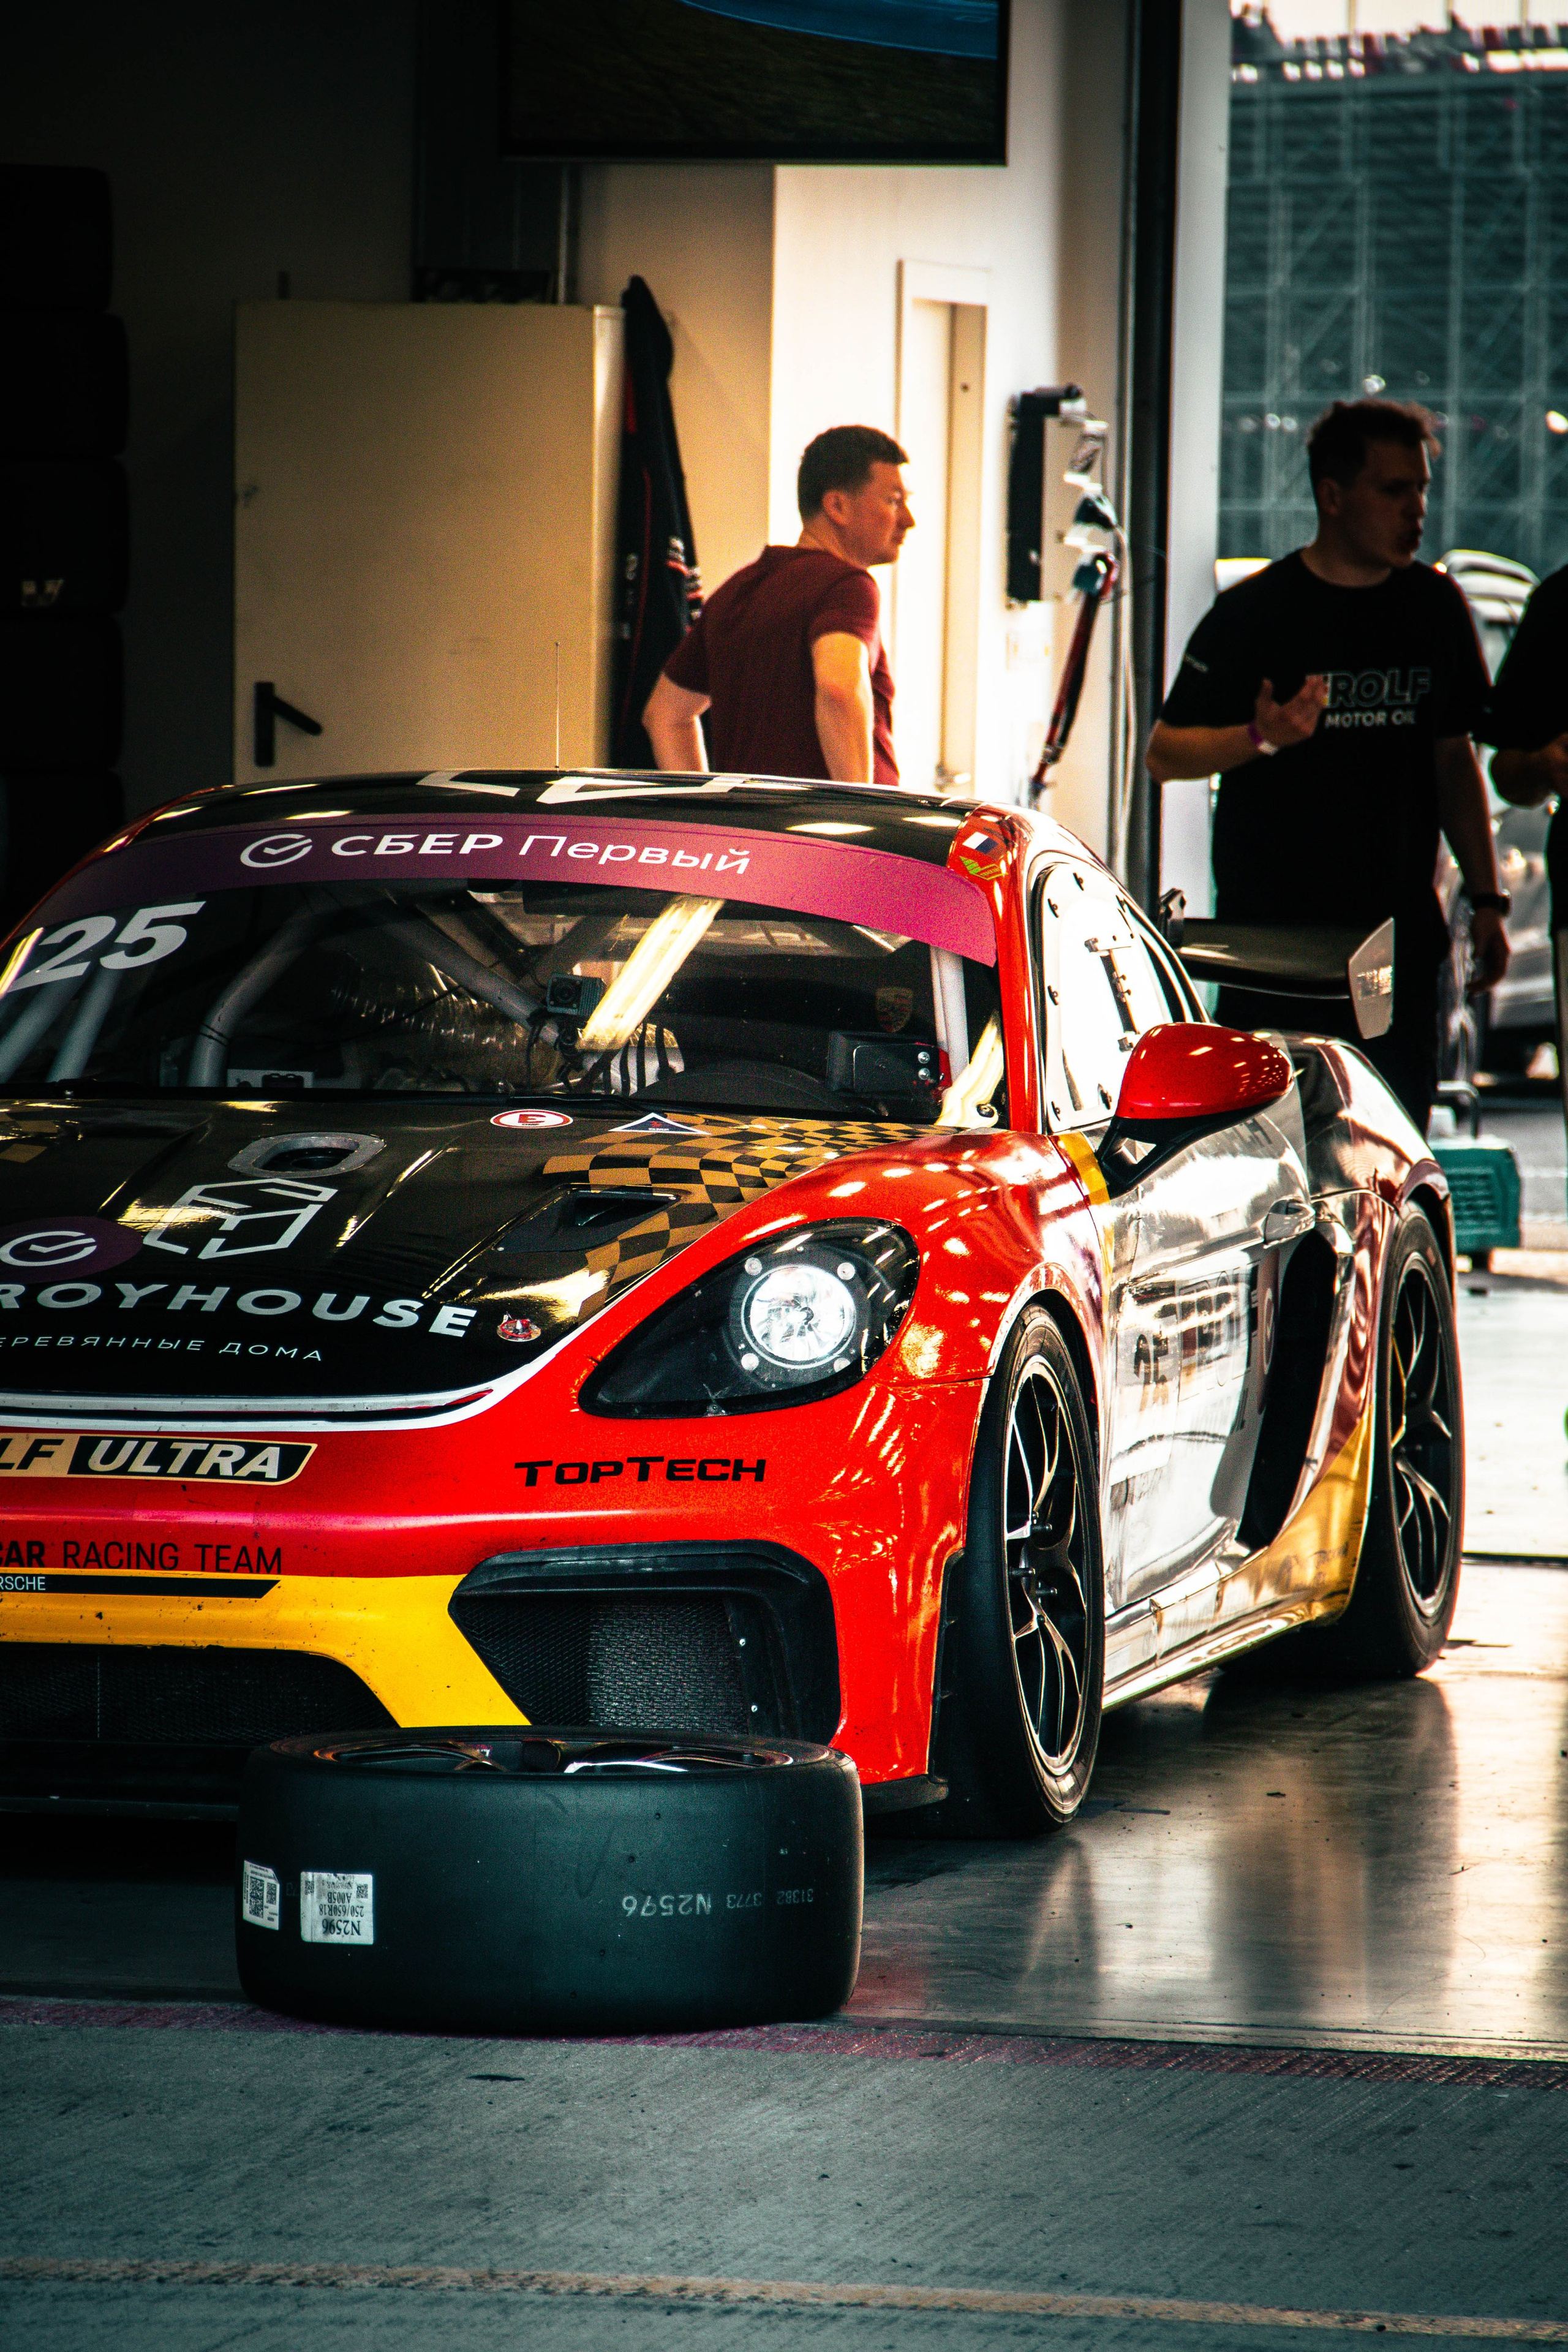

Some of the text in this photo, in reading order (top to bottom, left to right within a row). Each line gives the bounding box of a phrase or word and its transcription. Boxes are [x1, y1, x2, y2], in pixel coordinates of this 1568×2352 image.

[1327, 666, 1431, 708] ROLF
[1325, 710, 1387, 728] MOTOR
[331, 834, 750, 875] СБЕР Первый
[5, 901, 206, 993] 25
[518, 1114, 546, 1123] E
[219, 1343, 322, 1361] ДОМА
[88, 1440, 280, 1479] ULTRA
[0, 1540, 282, 1574] AR RACING TEAM
[327, 1892, 352, 1904] A005B
[622, 1893, 711, 1917] N2596
[319, 1904, 364, 1917] 250/650R18
[322, 1918, 361, 1936] N2596
